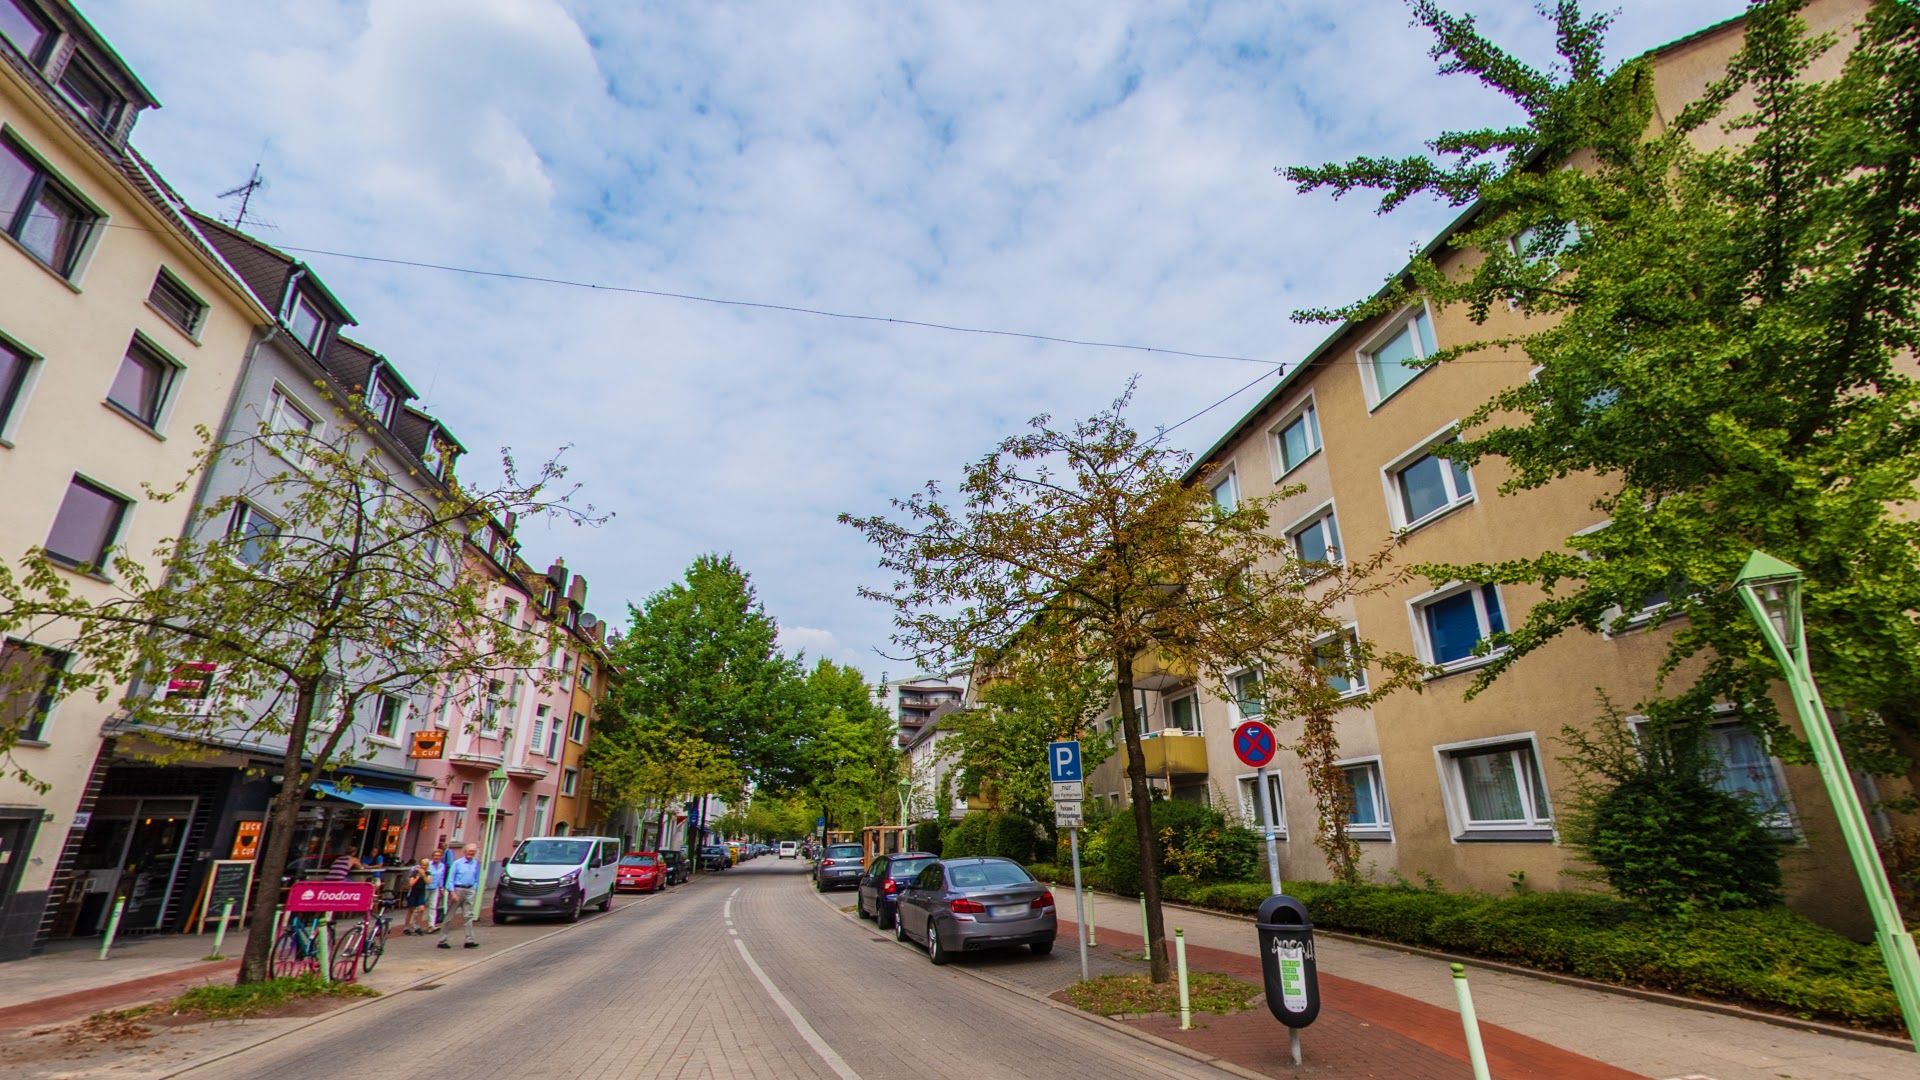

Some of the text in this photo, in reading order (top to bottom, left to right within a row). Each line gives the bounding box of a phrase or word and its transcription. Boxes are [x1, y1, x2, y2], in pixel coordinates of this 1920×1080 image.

[1056, 747, 1073, 777] P
[240, 822, 263, 830] LUCK
[241, 848, 256, 856] CUP
[317, 890, 361, 901] foodora
